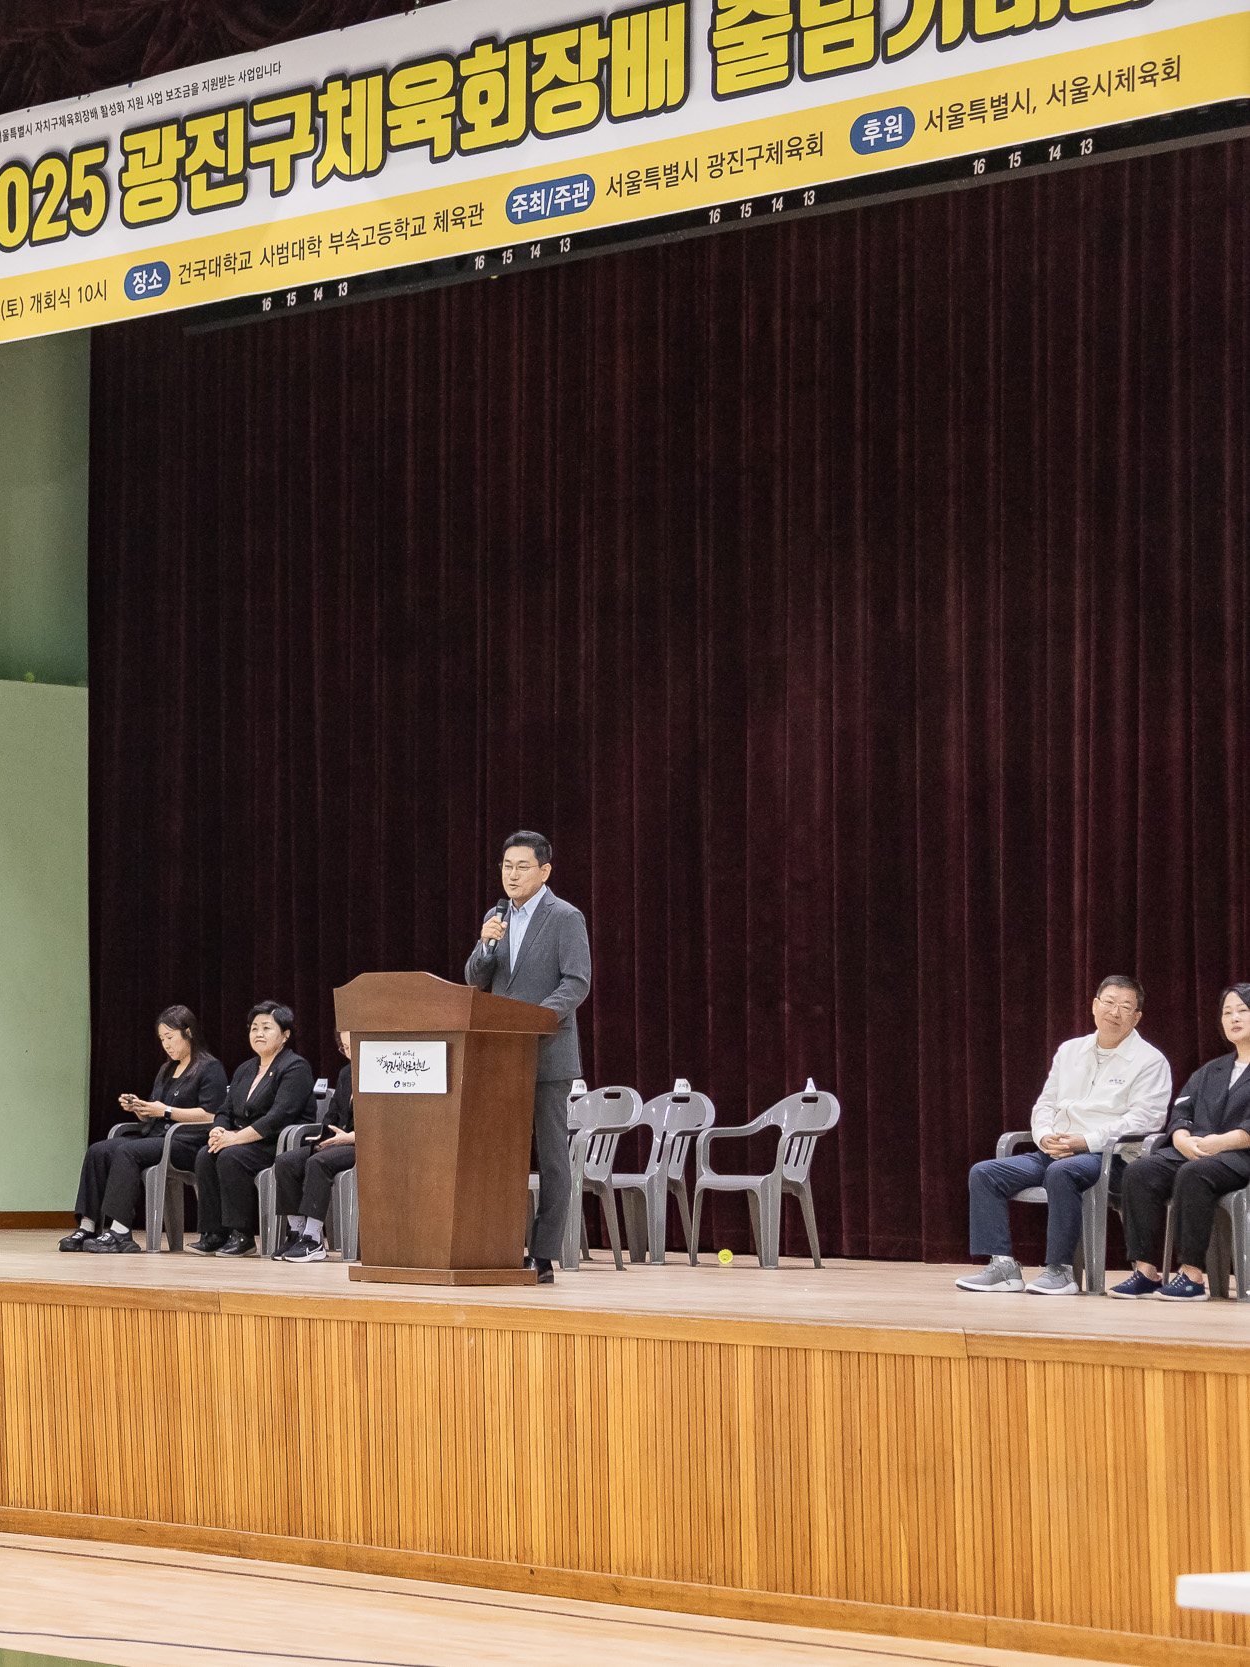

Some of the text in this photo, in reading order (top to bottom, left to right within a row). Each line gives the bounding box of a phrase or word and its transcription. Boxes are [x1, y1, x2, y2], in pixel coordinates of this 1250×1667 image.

[35, 110, 99, 133] 자치구체육회장배
[100, 100, 125, 118] 활성화
[127, 96, 144, 111] 지원
[146, 92, 163, 106] 사업
[166, 82, 199, 102] 보조금을
[202, 74, 236, 93] 지원받는
[238, 61, 281, 84] 사업입니다
[924, 54, 1182, 133] 서울특별시, 서울시체육회
[120, 1, 686, 224] 광진구체육회장배
[711, 0, 1150, 97] 줄넘기
[861, 113, 904, 147] 후원
[606, 130, 824, 198] 서울특별시 광진구체육회
[972, 139, 1093, 175] 16 15 14 13
[511, 179, 590, 220] 주최/주관
[708, 190, 815, 224] 16 15 14 13
[178, 202, 485, 285] 건국대학교 사범대학 부속고등학교 체육관
[474, 238, 571, 270] 16 15 14 13
[29, 286, 71, 314] 개회식
[77, 279, 108, 304] 10시
[132, 267, 163, 295] 장소
[261, 282, 348, 312] 16 15 14 13
